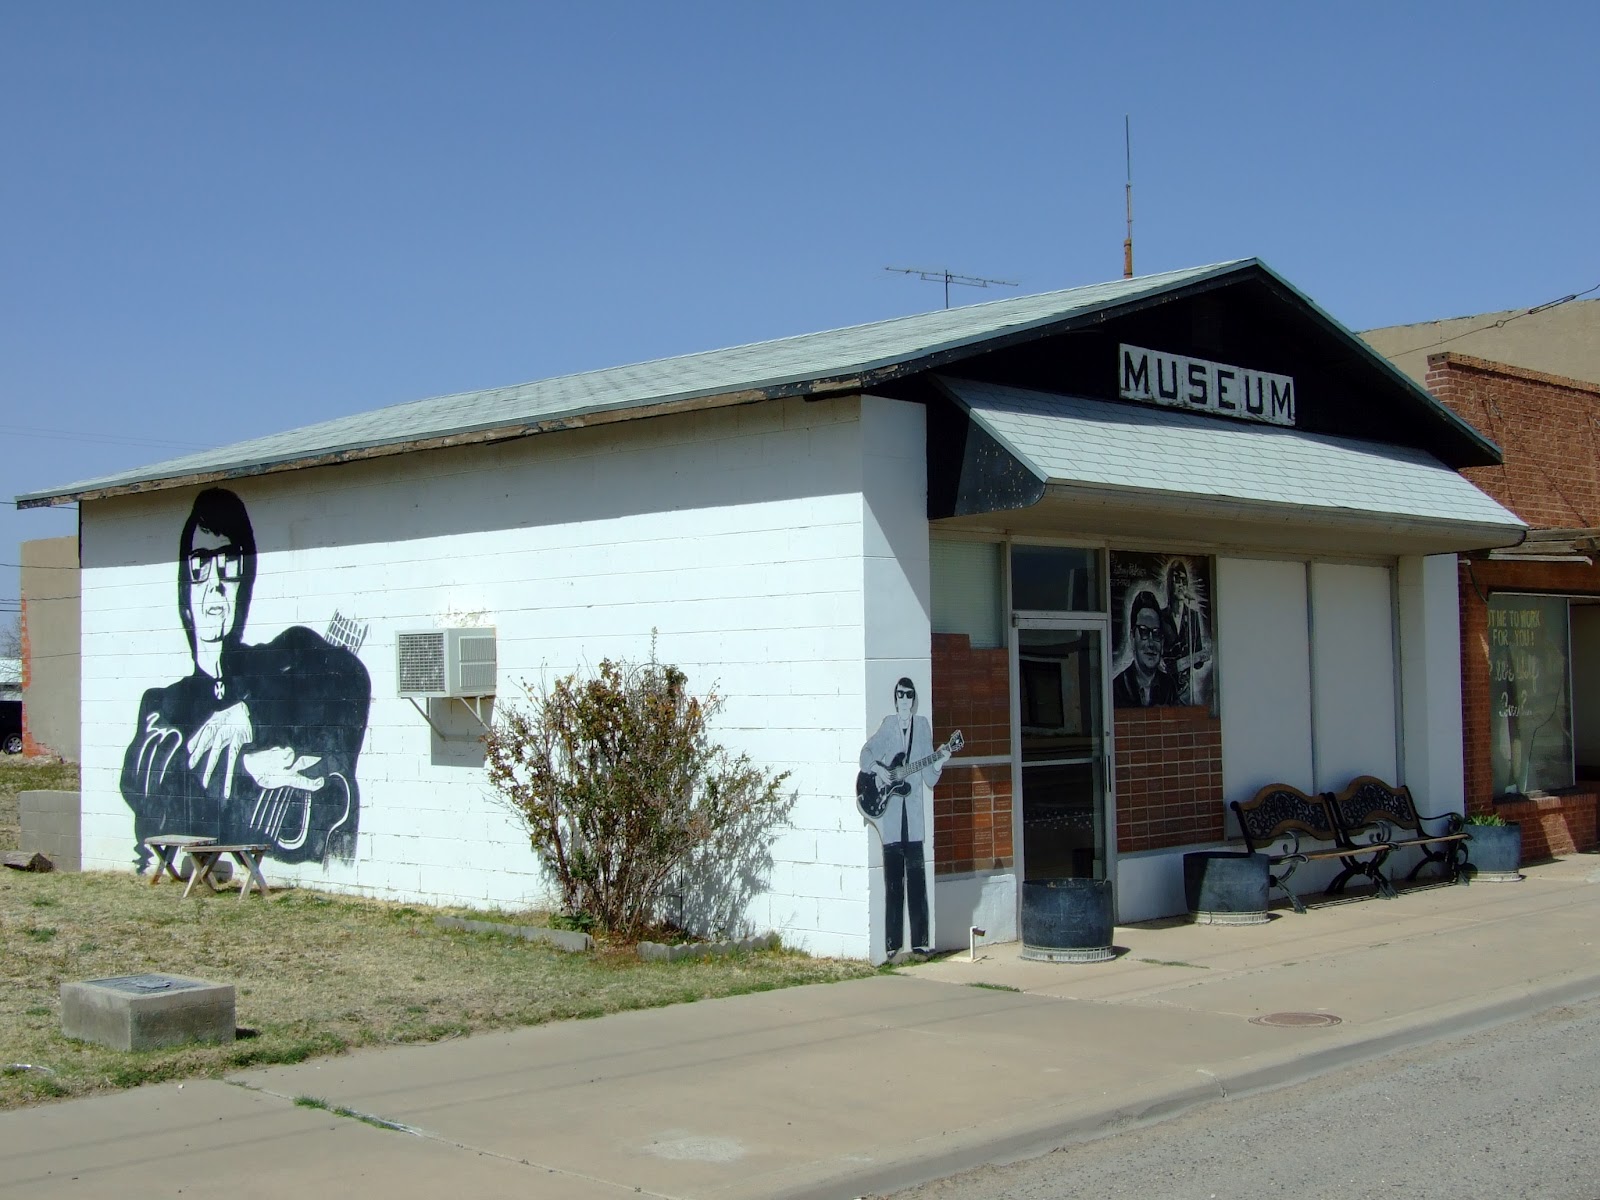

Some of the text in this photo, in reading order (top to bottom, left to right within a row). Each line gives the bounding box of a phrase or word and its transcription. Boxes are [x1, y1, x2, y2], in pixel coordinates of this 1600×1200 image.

[1124, 350, 1293, 420] MUSEUM
[1509, 609, 1519, 628] TO
[1520, 609, 1541, 628] WORK
[1493, 628, 1534, 647] FOR YOU!
